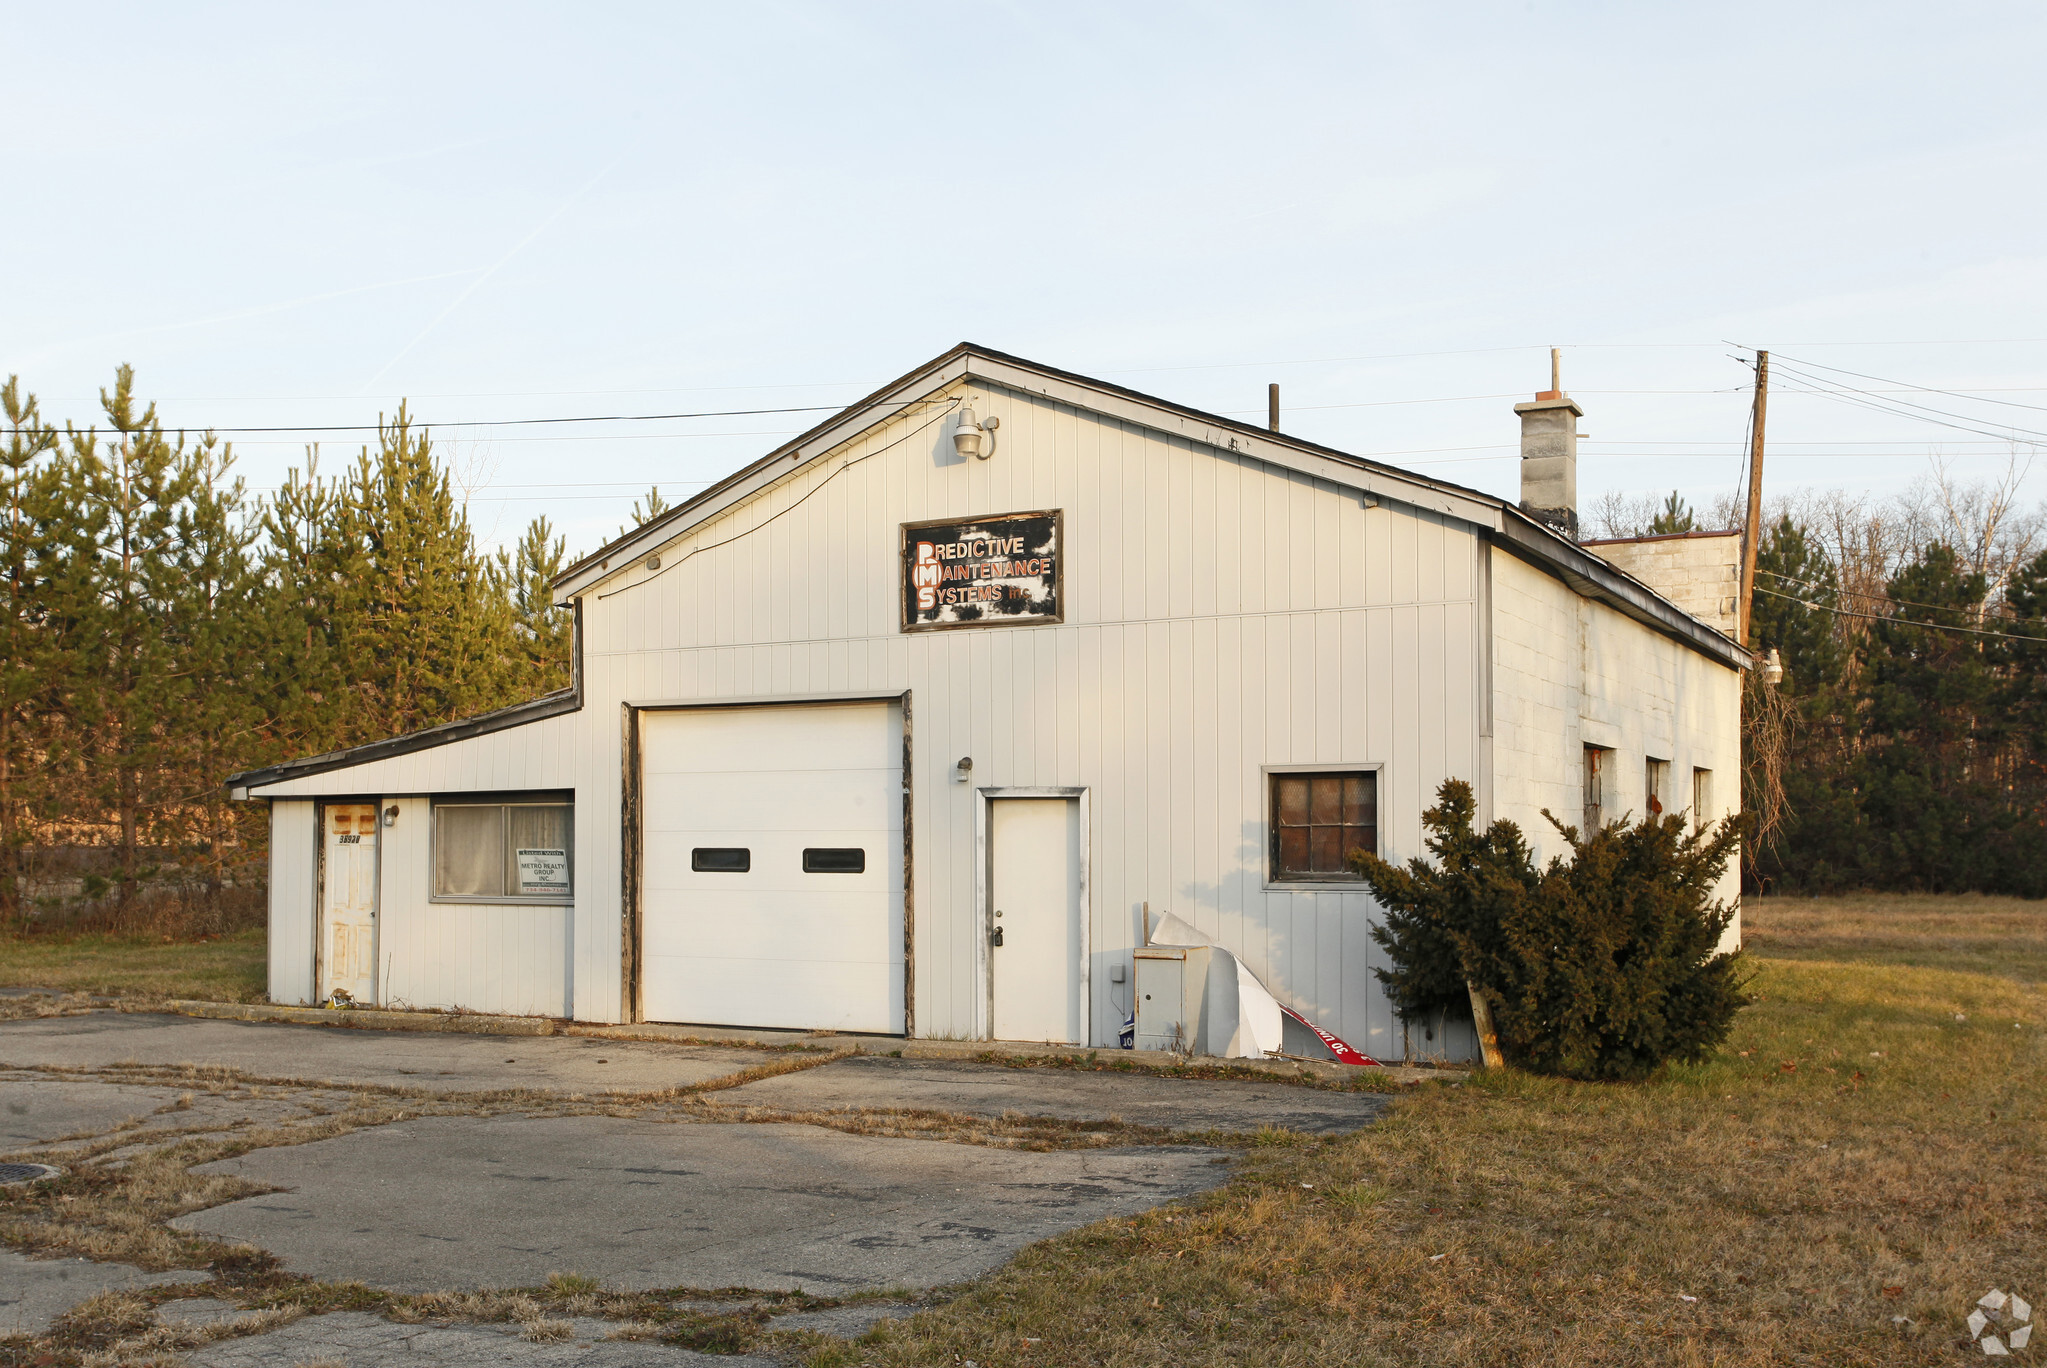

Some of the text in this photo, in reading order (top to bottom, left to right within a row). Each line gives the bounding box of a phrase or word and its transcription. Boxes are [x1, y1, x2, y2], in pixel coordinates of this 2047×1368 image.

[917, 537, 1025, 564] PREDICTIVE
[918, 558, 1051, 588] MAINTENANCE
[917, 585, 1003, 610] SYSTEMS
